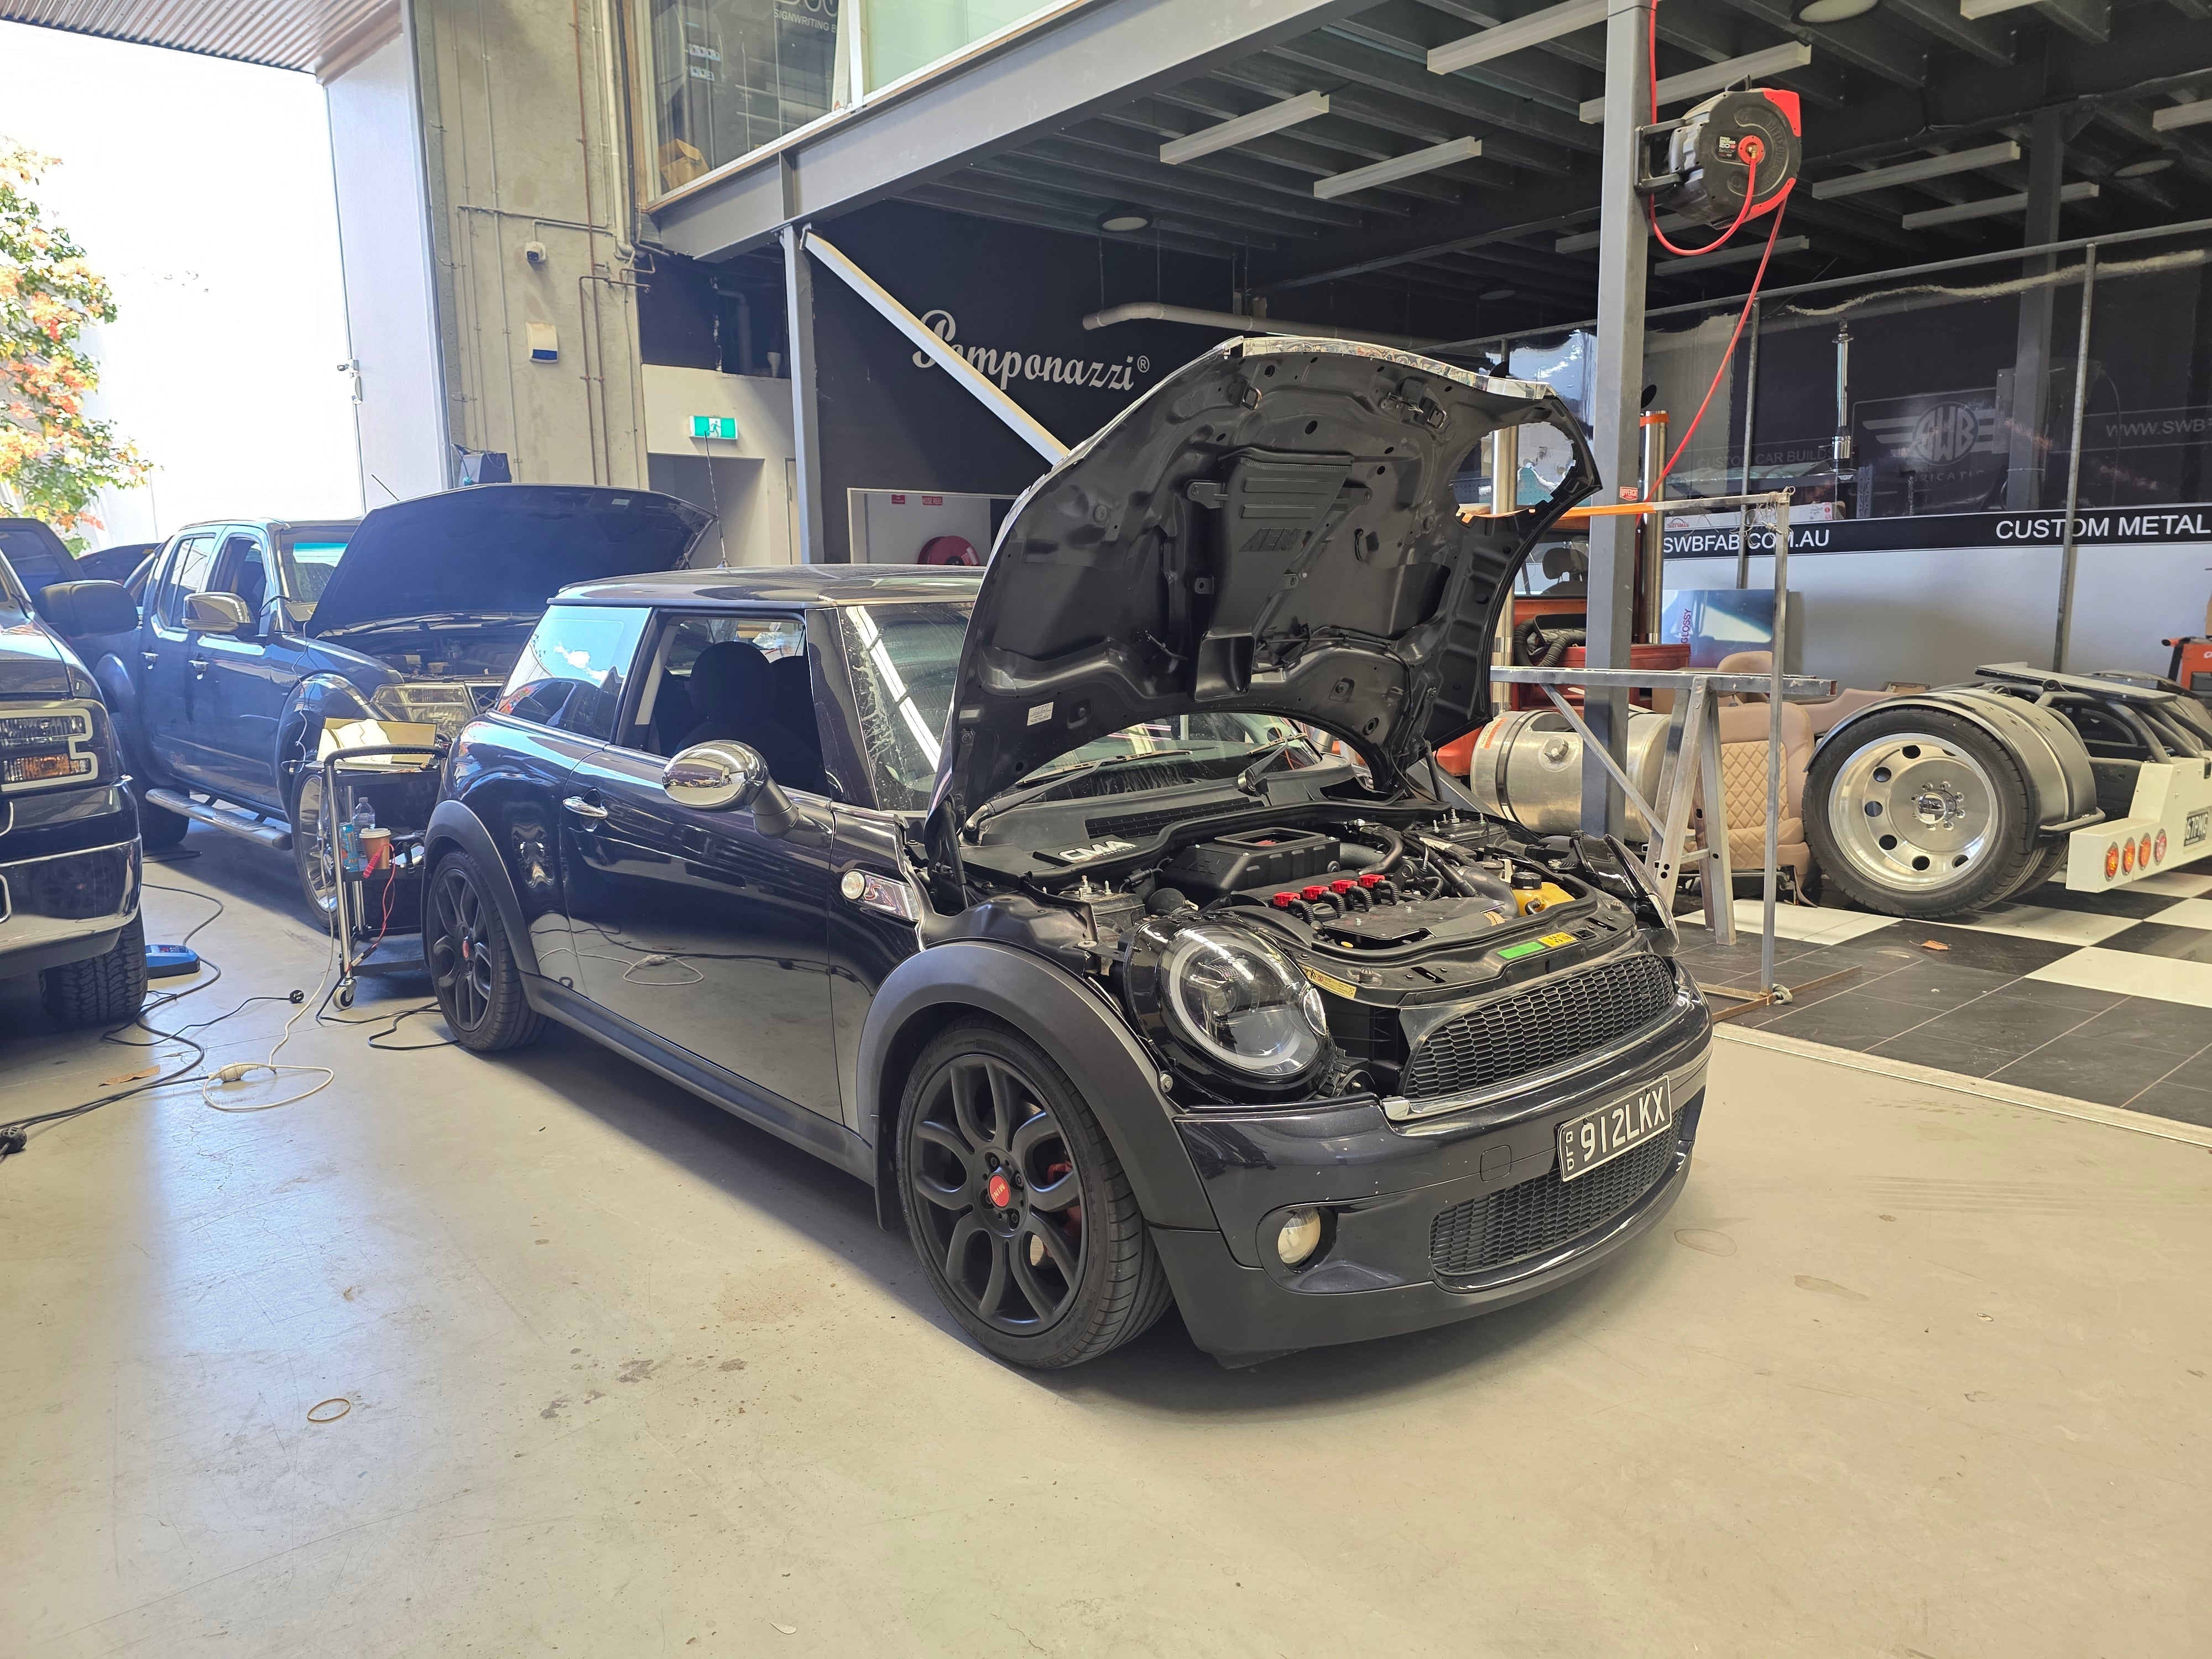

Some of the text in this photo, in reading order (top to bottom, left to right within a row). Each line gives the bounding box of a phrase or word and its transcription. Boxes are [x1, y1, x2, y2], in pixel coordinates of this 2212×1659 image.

[774, 8, 830, 32] SIGNWRITING
[2105, 418, 2212, 437] WWW.SWB
[1697, 455, 1744, 468] CUSTO
[1755, 452, 1783, 465] CAR
[1996, 513, 2211, 539] CUSTOM METAL
[1663, 529, 1830, 553] SWBFABCO.AU
[1681, 608, 1691, 644] GLOSSY
[1059, 841, 1138, 860] CMA
[1103, 845, 1138, 856] AUSTRALIA
[1580, 1086, 1665, 1162] 912LKX
[1566, 1130, 1574, 1172] QLD
[992, 1183, 1005, 1201] MINI
